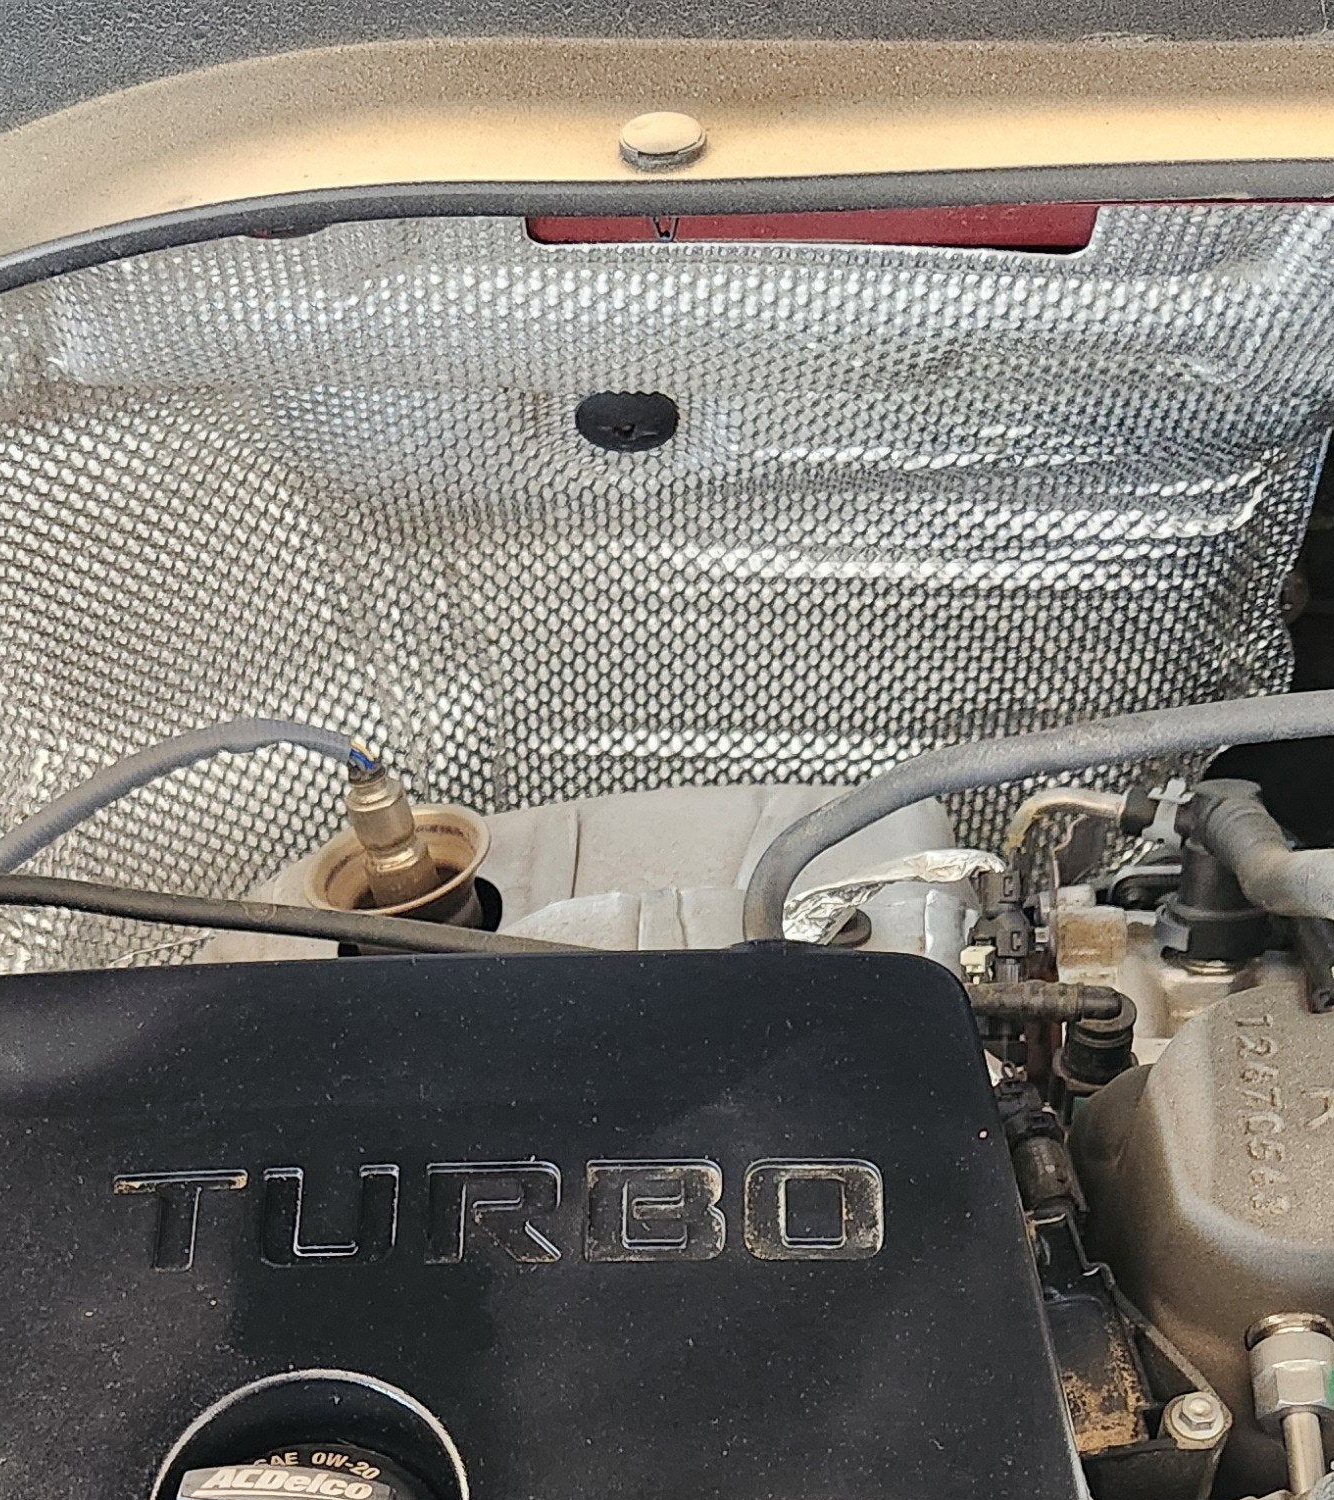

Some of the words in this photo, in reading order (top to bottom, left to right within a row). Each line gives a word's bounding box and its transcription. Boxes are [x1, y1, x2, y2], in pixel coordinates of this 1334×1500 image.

[113, 1157, 885, 1272] TURBO
[311, 1451, 381, 1480] 0W-20
[201, 1467, 373, 1500] ACDelco
